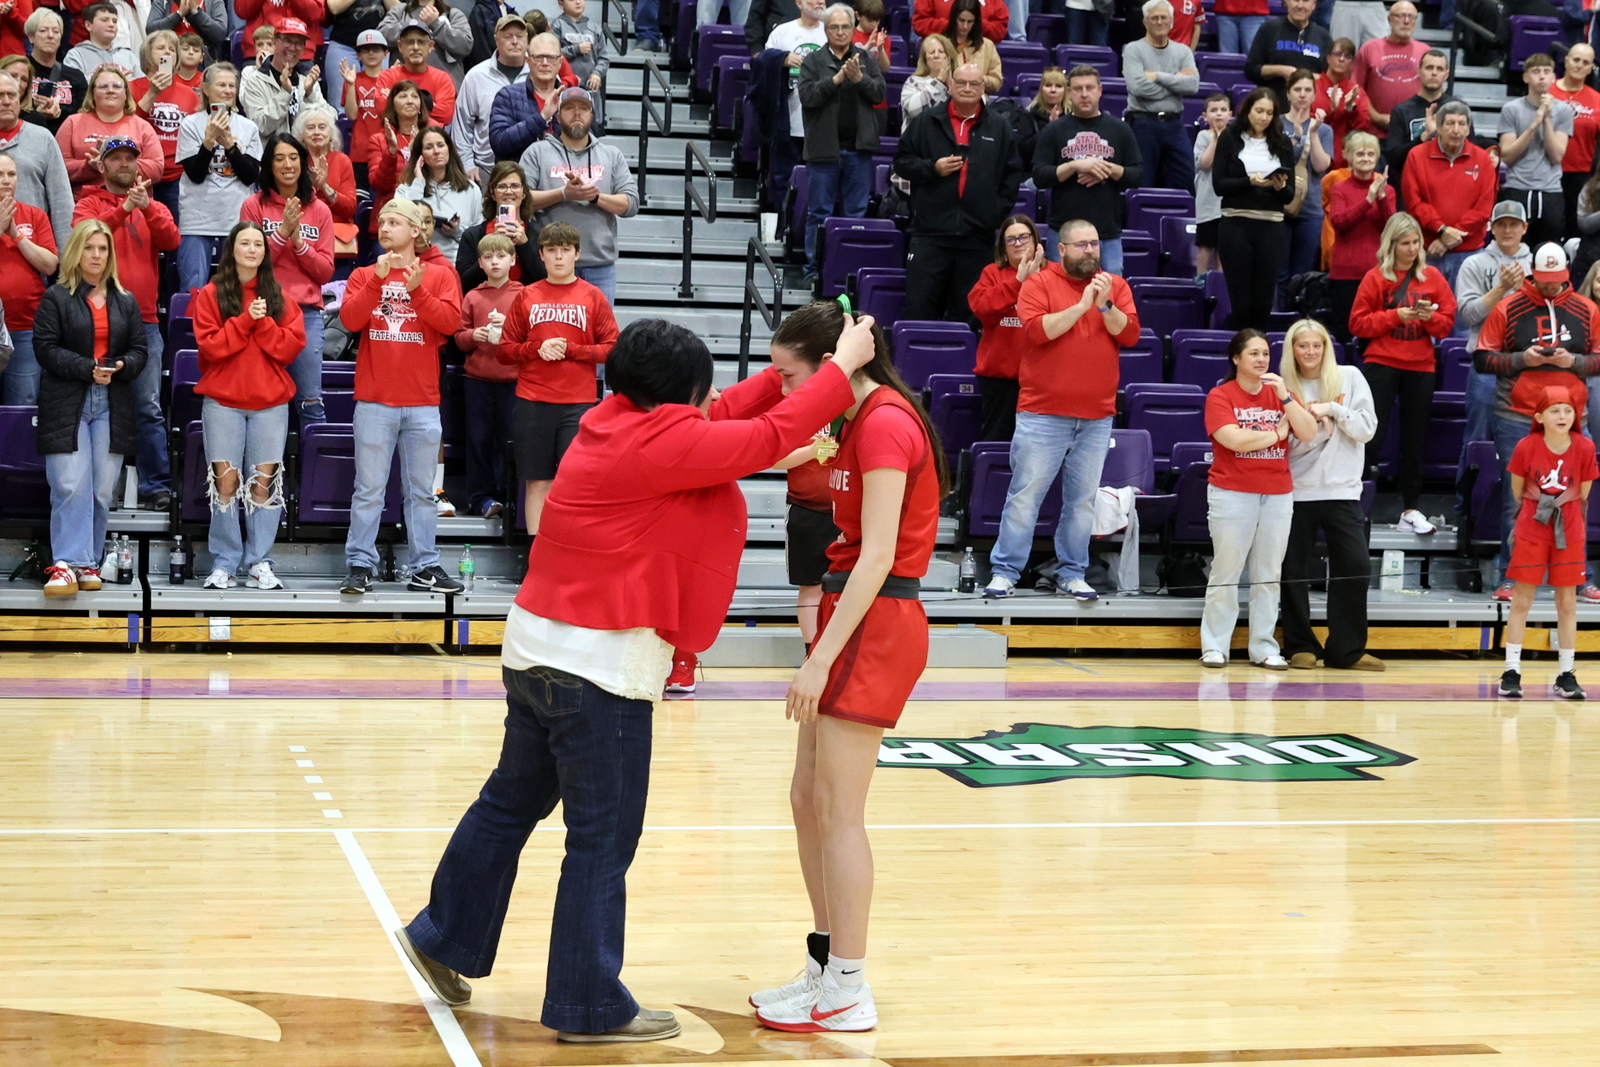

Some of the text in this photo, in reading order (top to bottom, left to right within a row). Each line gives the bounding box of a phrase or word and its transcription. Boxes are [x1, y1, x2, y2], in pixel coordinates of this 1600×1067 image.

[1075, 136, 1100, 144] STATE
[1062, 144, 1114, 157] CHAMPIONS
[529, 304, 587, 332] REDMEN
[369, 330, 390, 340] TATE
[877, 739, 1379, 766] OHSAA
